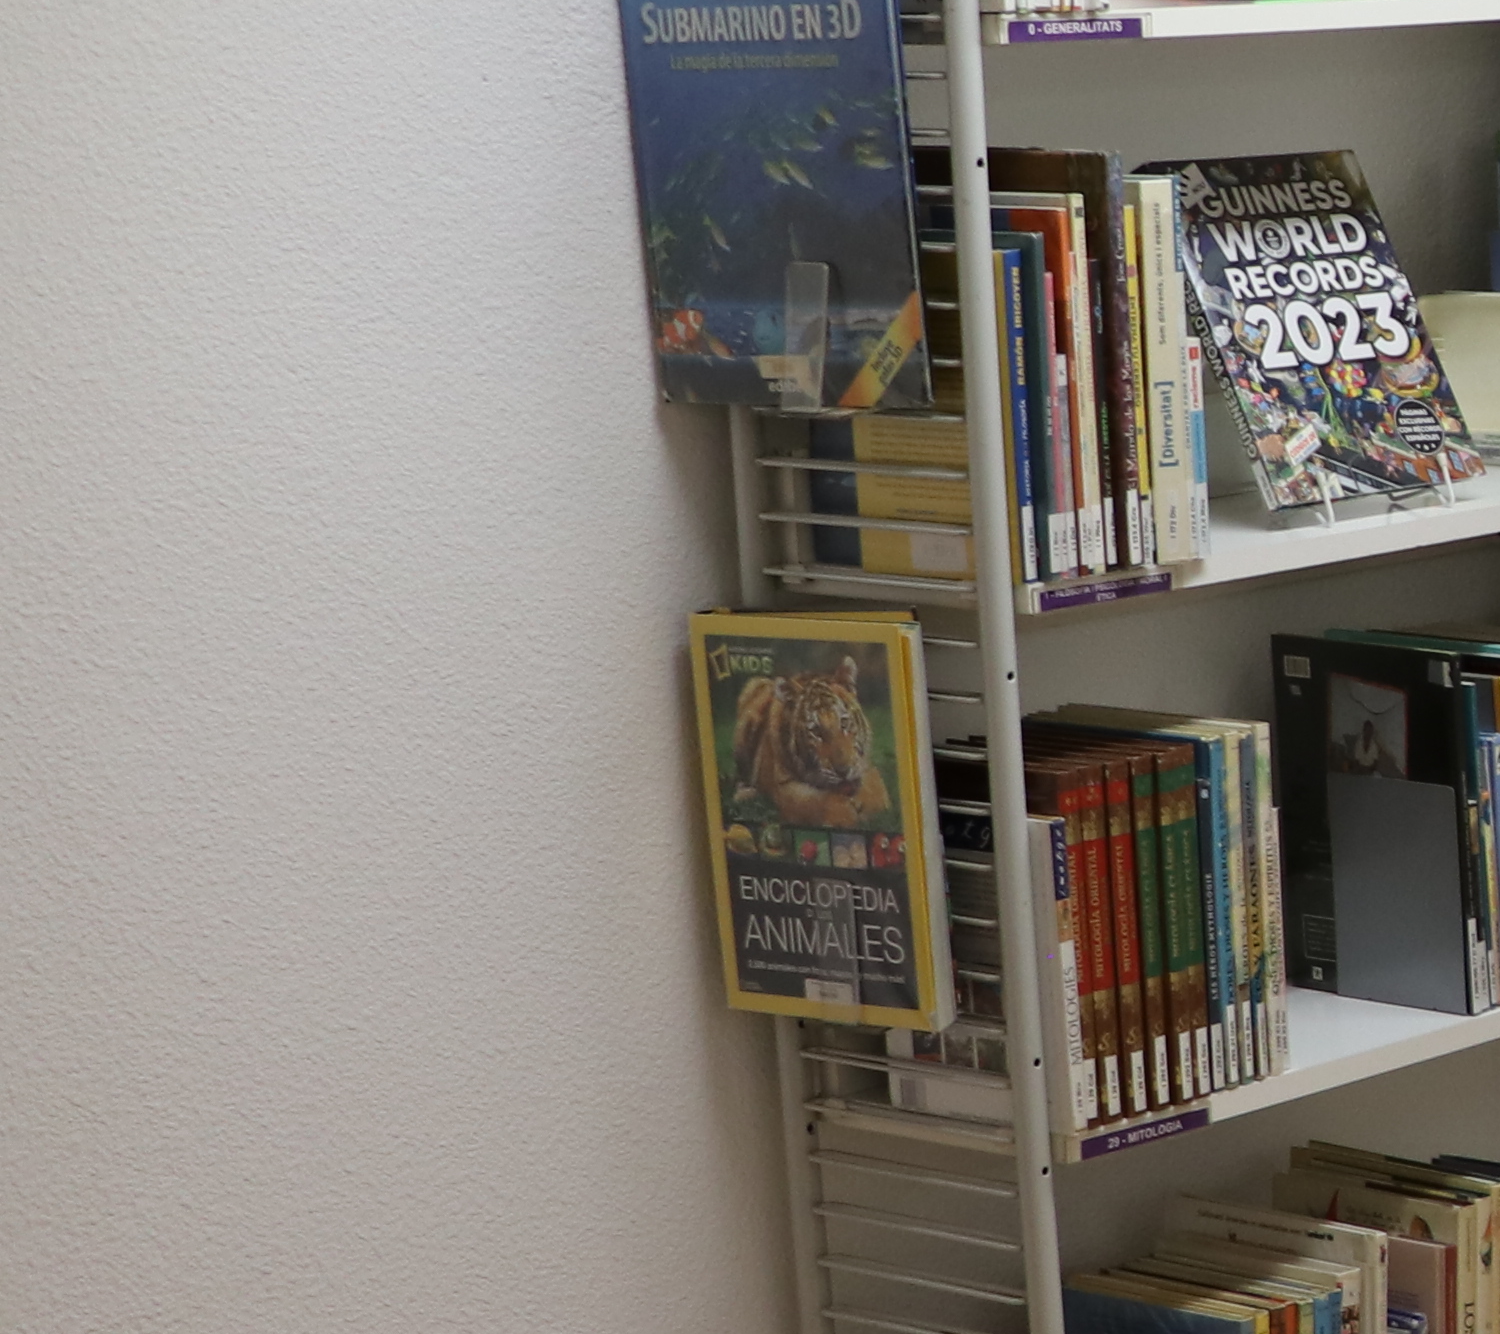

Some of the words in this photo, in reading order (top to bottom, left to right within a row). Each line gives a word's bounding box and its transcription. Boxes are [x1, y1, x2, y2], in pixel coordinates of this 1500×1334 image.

[641, 2, 787, 44] SUBMARINO
[790, 4, 823, 40] EN
[1027, 22, 1036, 36] 0
[1043, 19, 1123, 36] GENERALITATS
[1201, 177, 1353, 219] GUINNESS
[1207, 213, 1367, 264] WORLD
[1011, 266, 1023, 329] IRIGOYEN
[1224, 254, 1387, 301] RECORDS
[1193, 315, 1227, 378] WORLD
[1244, 289, 1413, 370] 2023
[1013, 336, 1026, 386] RAMÓN
[1155, 381, 1178, 468] [Diversitat]
[1219, 376, 1259, 460] GUINNESS
[730, 654, 773, 675] KIDS
[739, 874, 900, 914] ENCICLOPEDIA
[1086, 846, 1099, 907] ORIENTAL
[744, 914, 907, 965] ANIMALES
[1063, 965, 1083, 1066] MITOLOGIES
[1106, 1133, 1121, 1150] 29
[1128, 1118, 1184, 1145] MITOLOGIA
